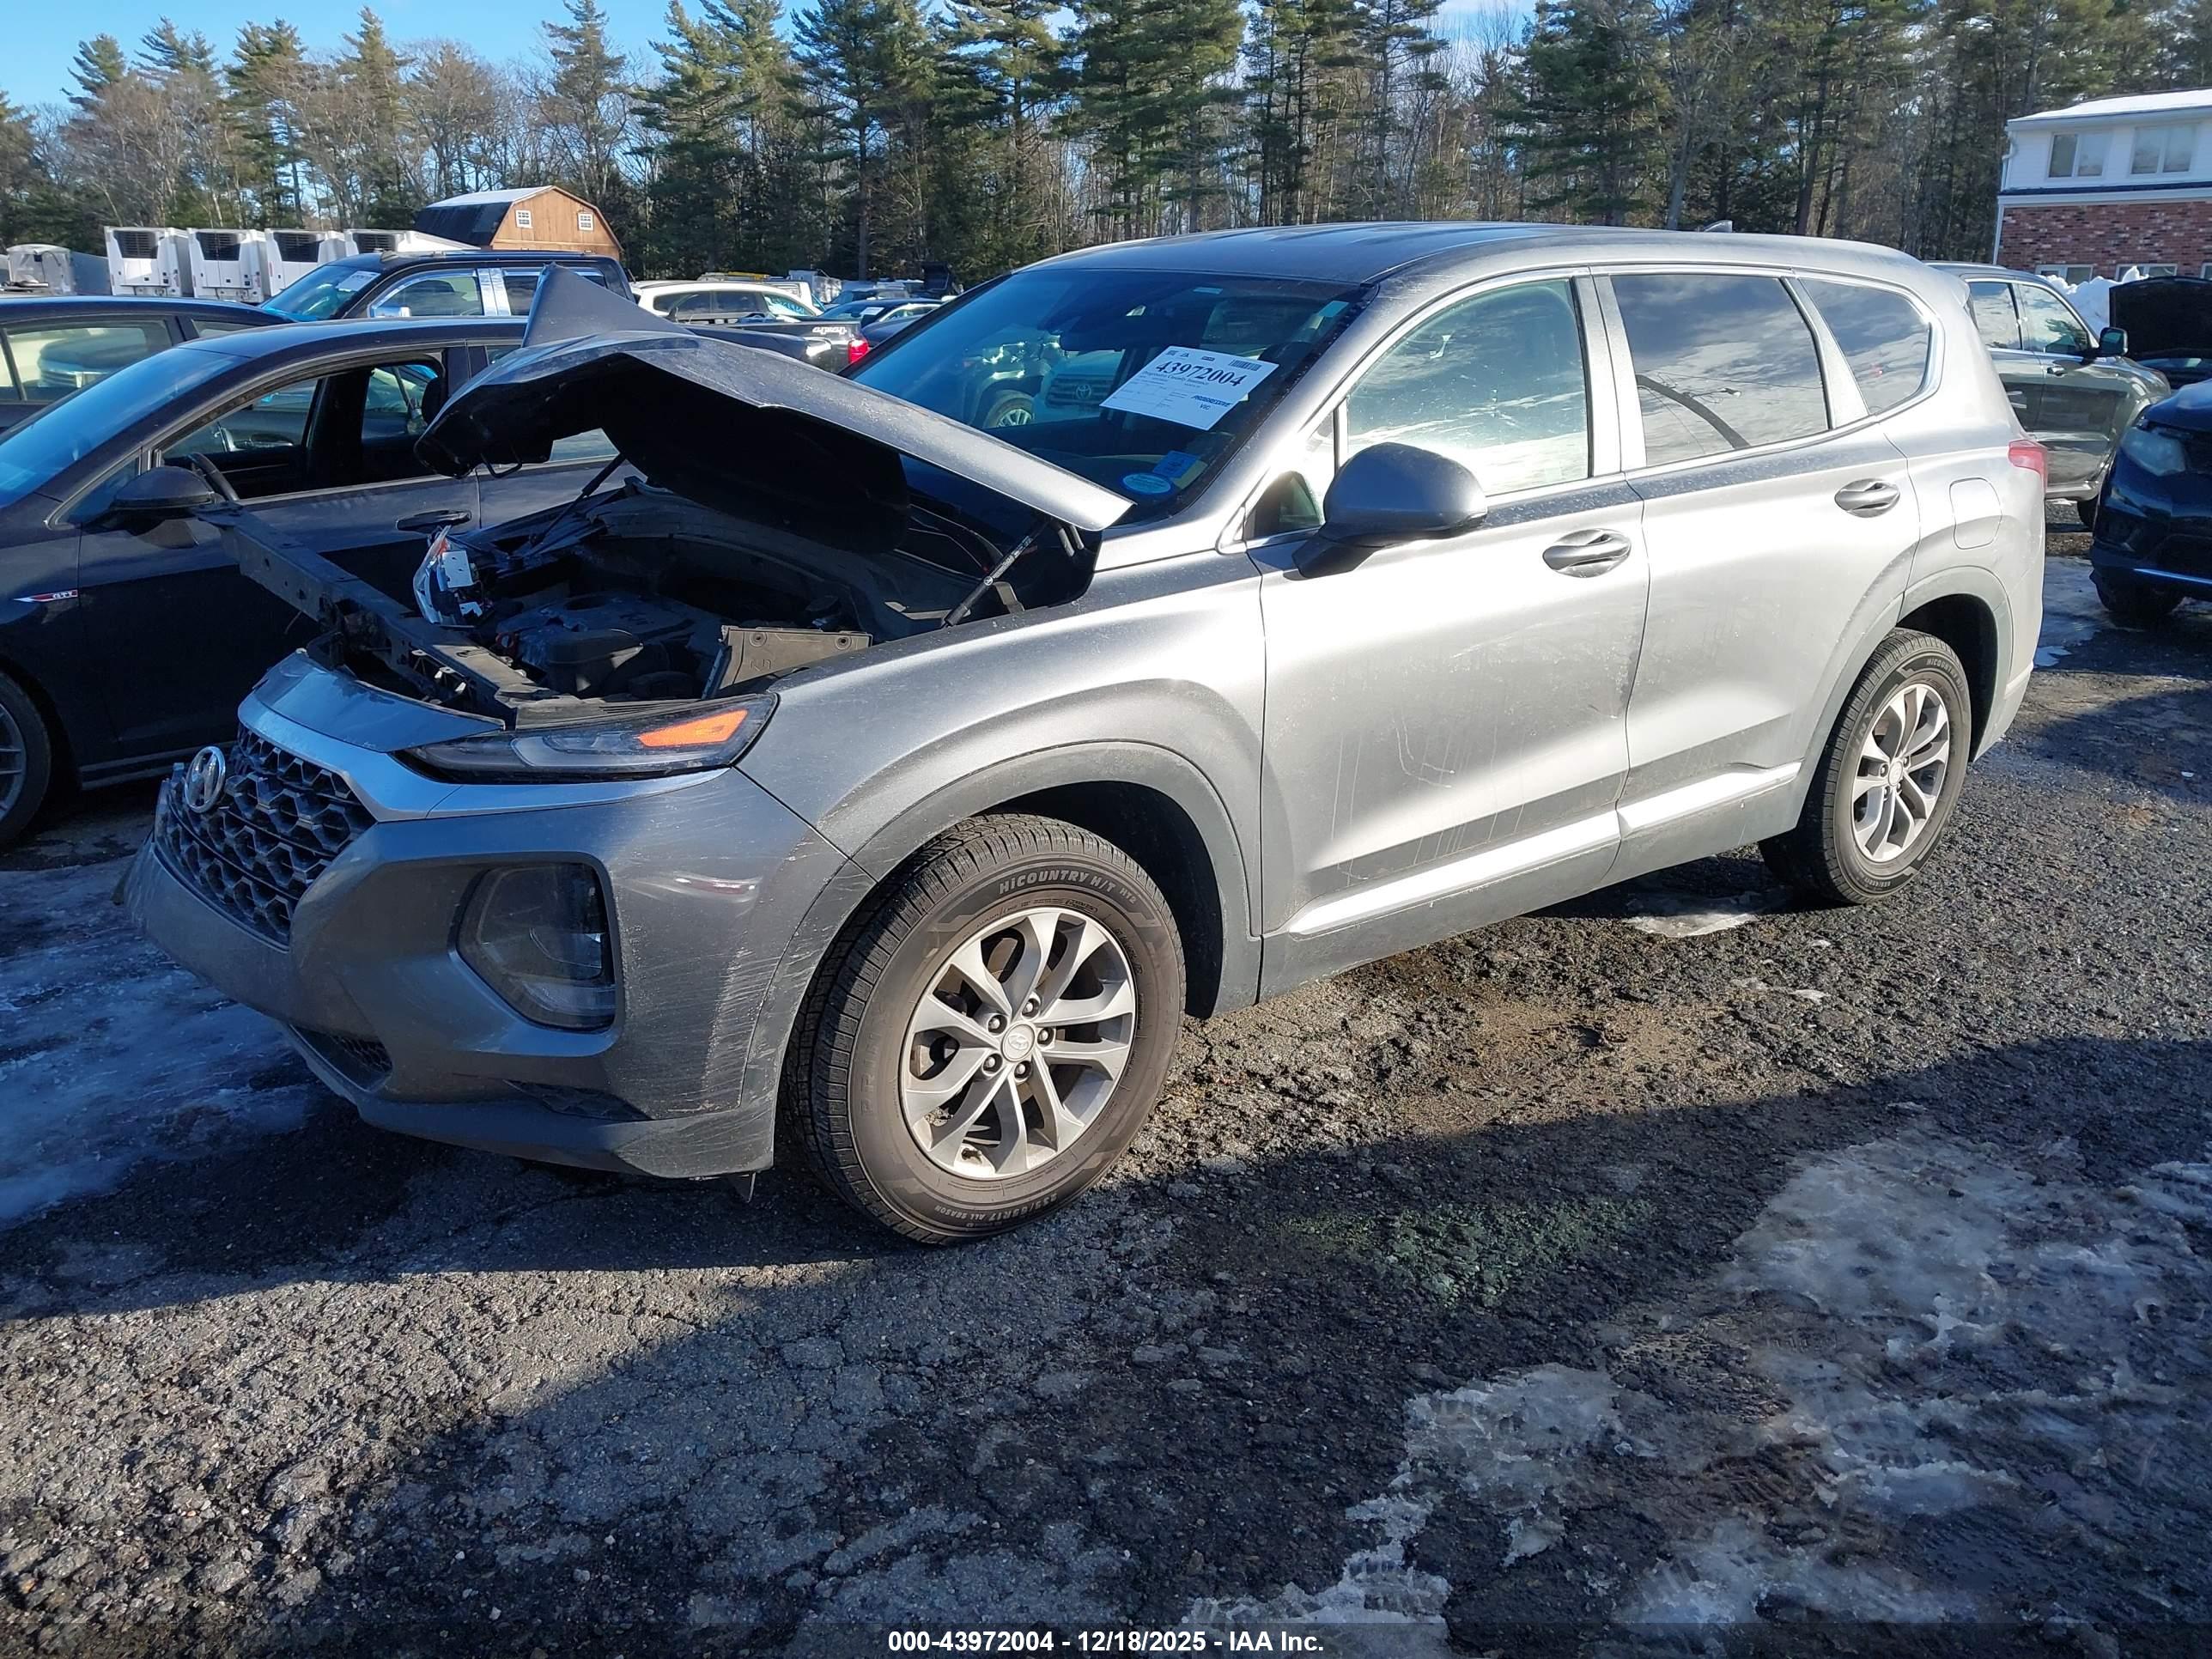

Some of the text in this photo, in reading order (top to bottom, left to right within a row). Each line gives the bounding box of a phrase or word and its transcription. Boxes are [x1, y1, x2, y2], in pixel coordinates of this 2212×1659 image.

[1156, 361, 1248, 386] 43972004
[53, 589, 79, 600] GTI
[1090, 875, 1116, 893] H/T
[1119, 887, 1139, 905] HT2
[934, 1205, 967, 1220] SEASON
[969, 1212, 987, 1221] ALL
